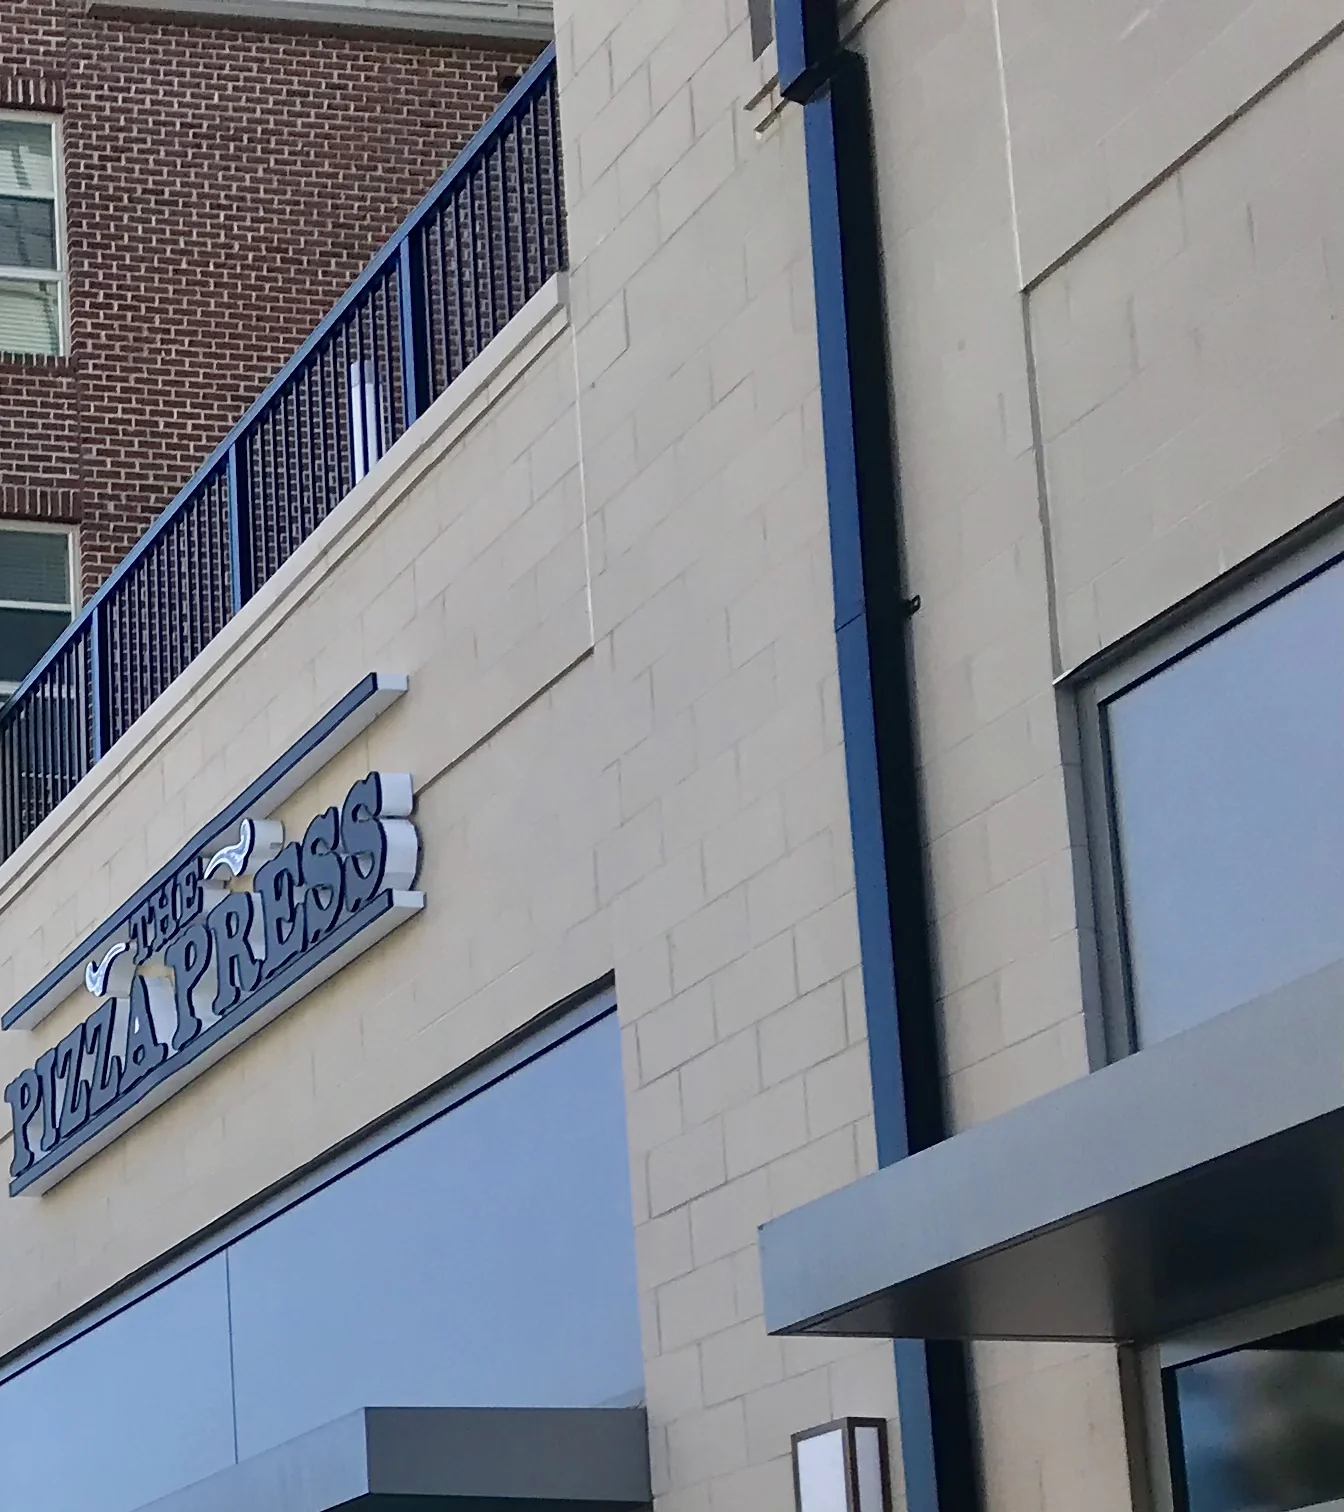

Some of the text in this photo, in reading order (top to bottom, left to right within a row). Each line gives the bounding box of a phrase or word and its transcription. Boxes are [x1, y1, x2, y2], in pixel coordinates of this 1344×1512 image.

[4, 771, 392, 1178] PIZZA PRESS
[128, 855, 207, 964] THE
